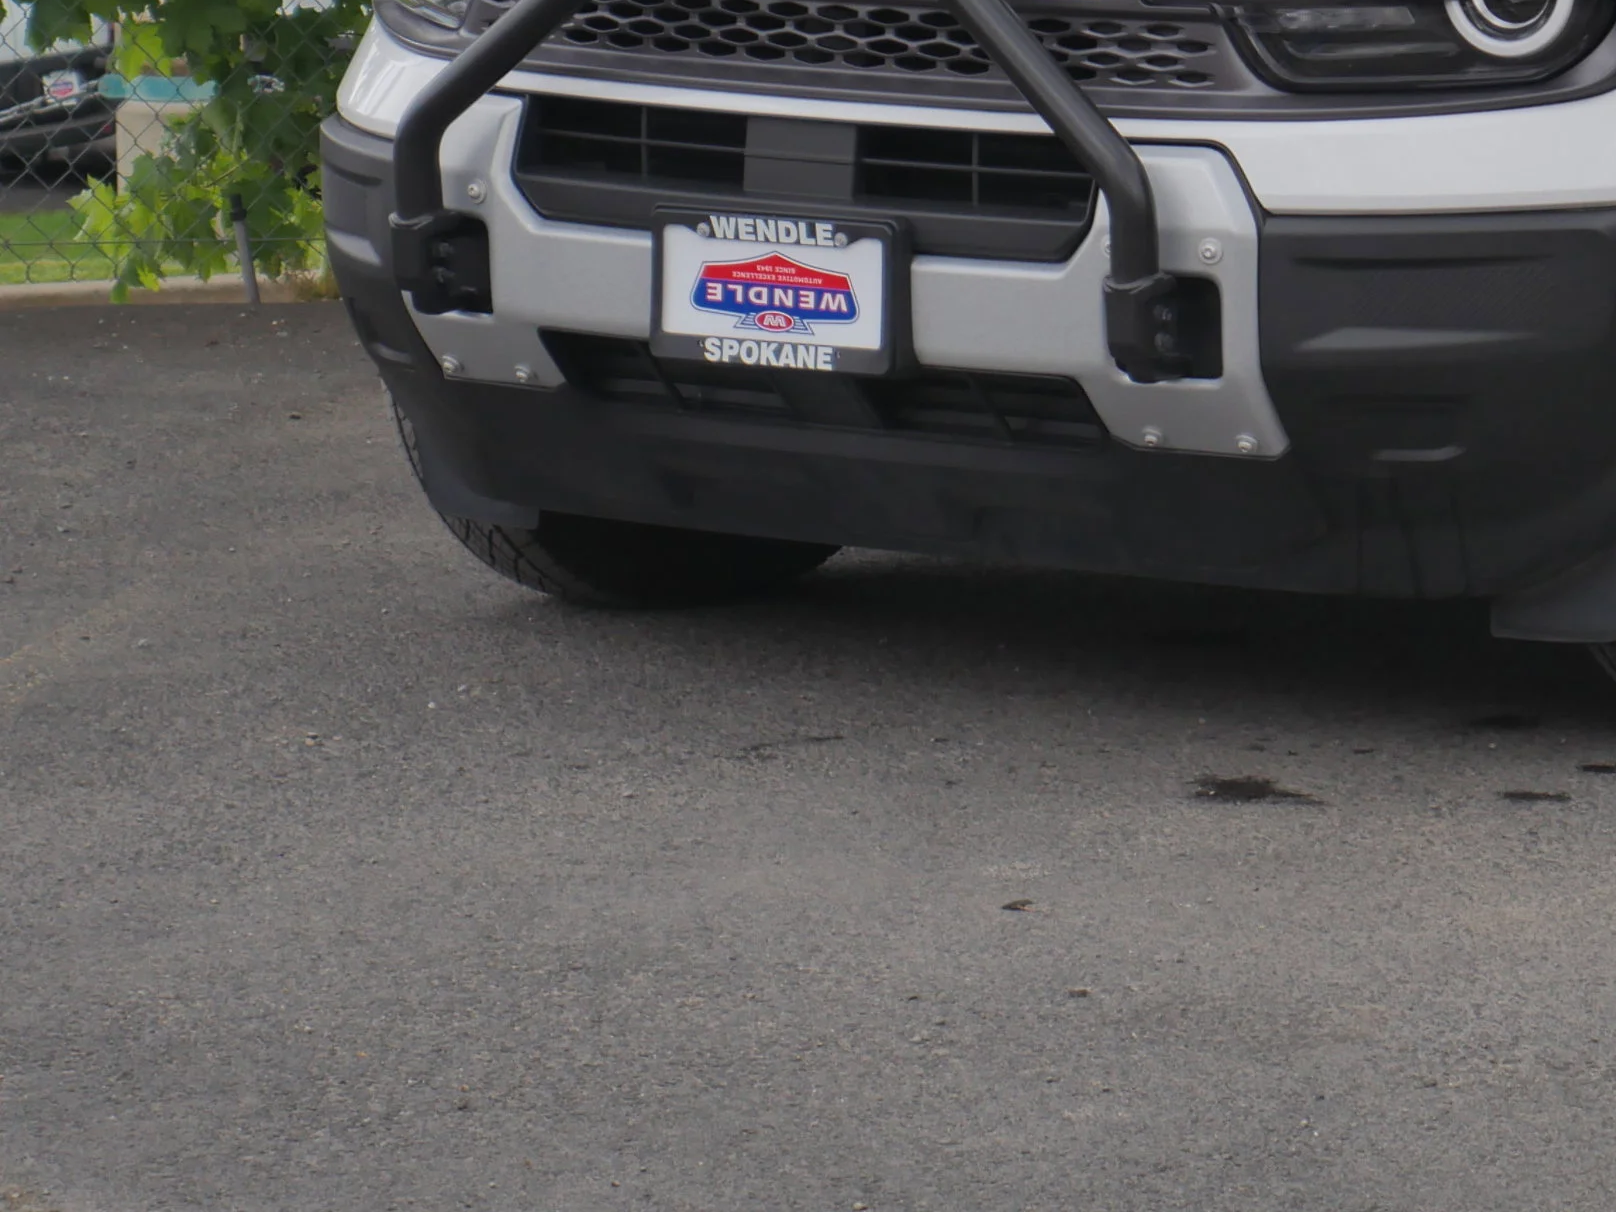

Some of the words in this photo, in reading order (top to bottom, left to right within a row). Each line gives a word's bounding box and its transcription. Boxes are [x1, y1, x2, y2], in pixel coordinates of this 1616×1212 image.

[709, 215, 834, 246] WENDLE
[706, 282, 848, 312] WENDLE
[703, 337, 833, 370] SPOKANE
